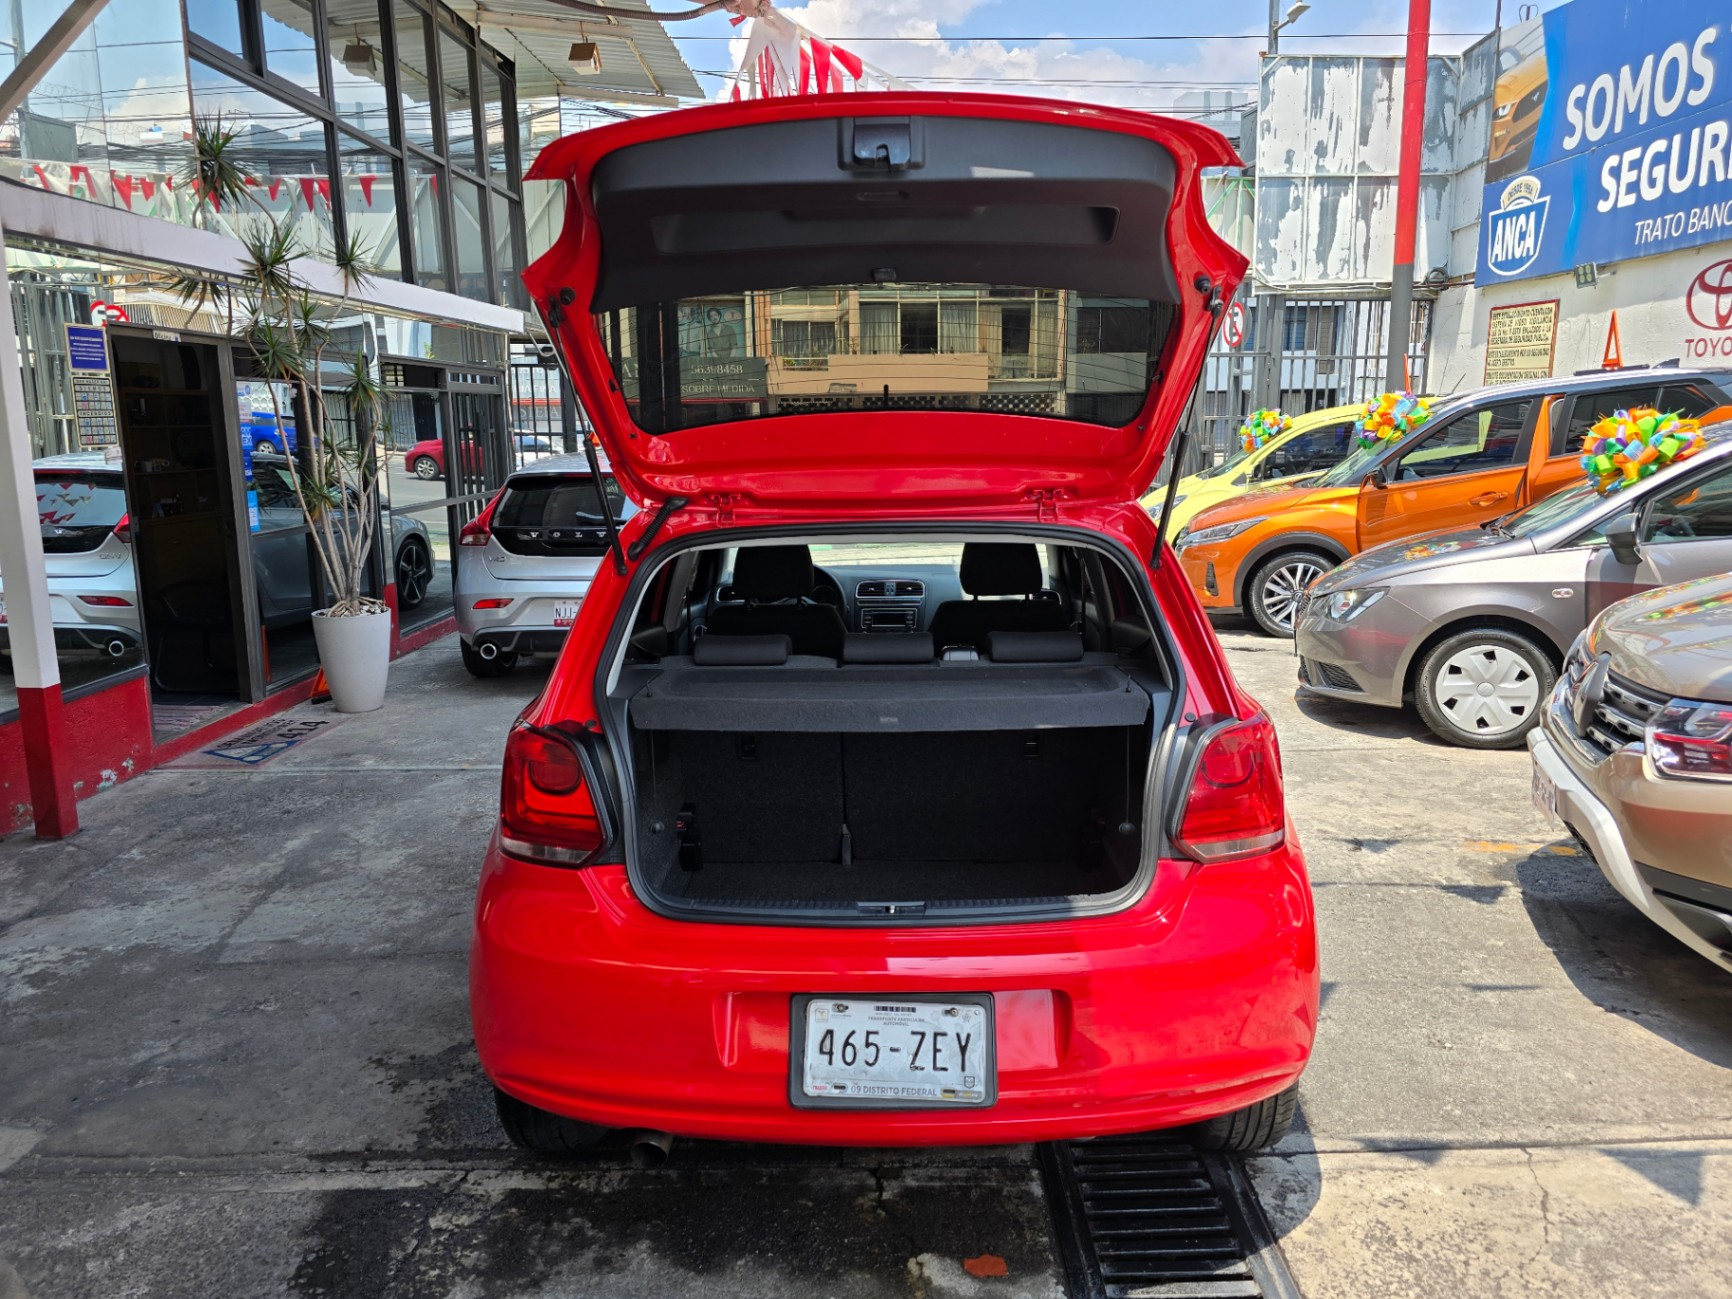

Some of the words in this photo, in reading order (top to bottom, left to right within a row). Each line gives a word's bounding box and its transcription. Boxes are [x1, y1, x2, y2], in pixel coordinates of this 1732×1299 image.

[1562, 26, 1717, 152] SOMOS
[1491, 211, 1535, 264] ANCA
[1635, 211, 1685, 245] TRATO
[1685, 336, 1732, 358] TOYO
[818, 1028, 971, 1073] 465-ZEY
[863, 1086, 900, 1095] DISTRITO
[901, 1087, 938, 1096] FEDERAL
